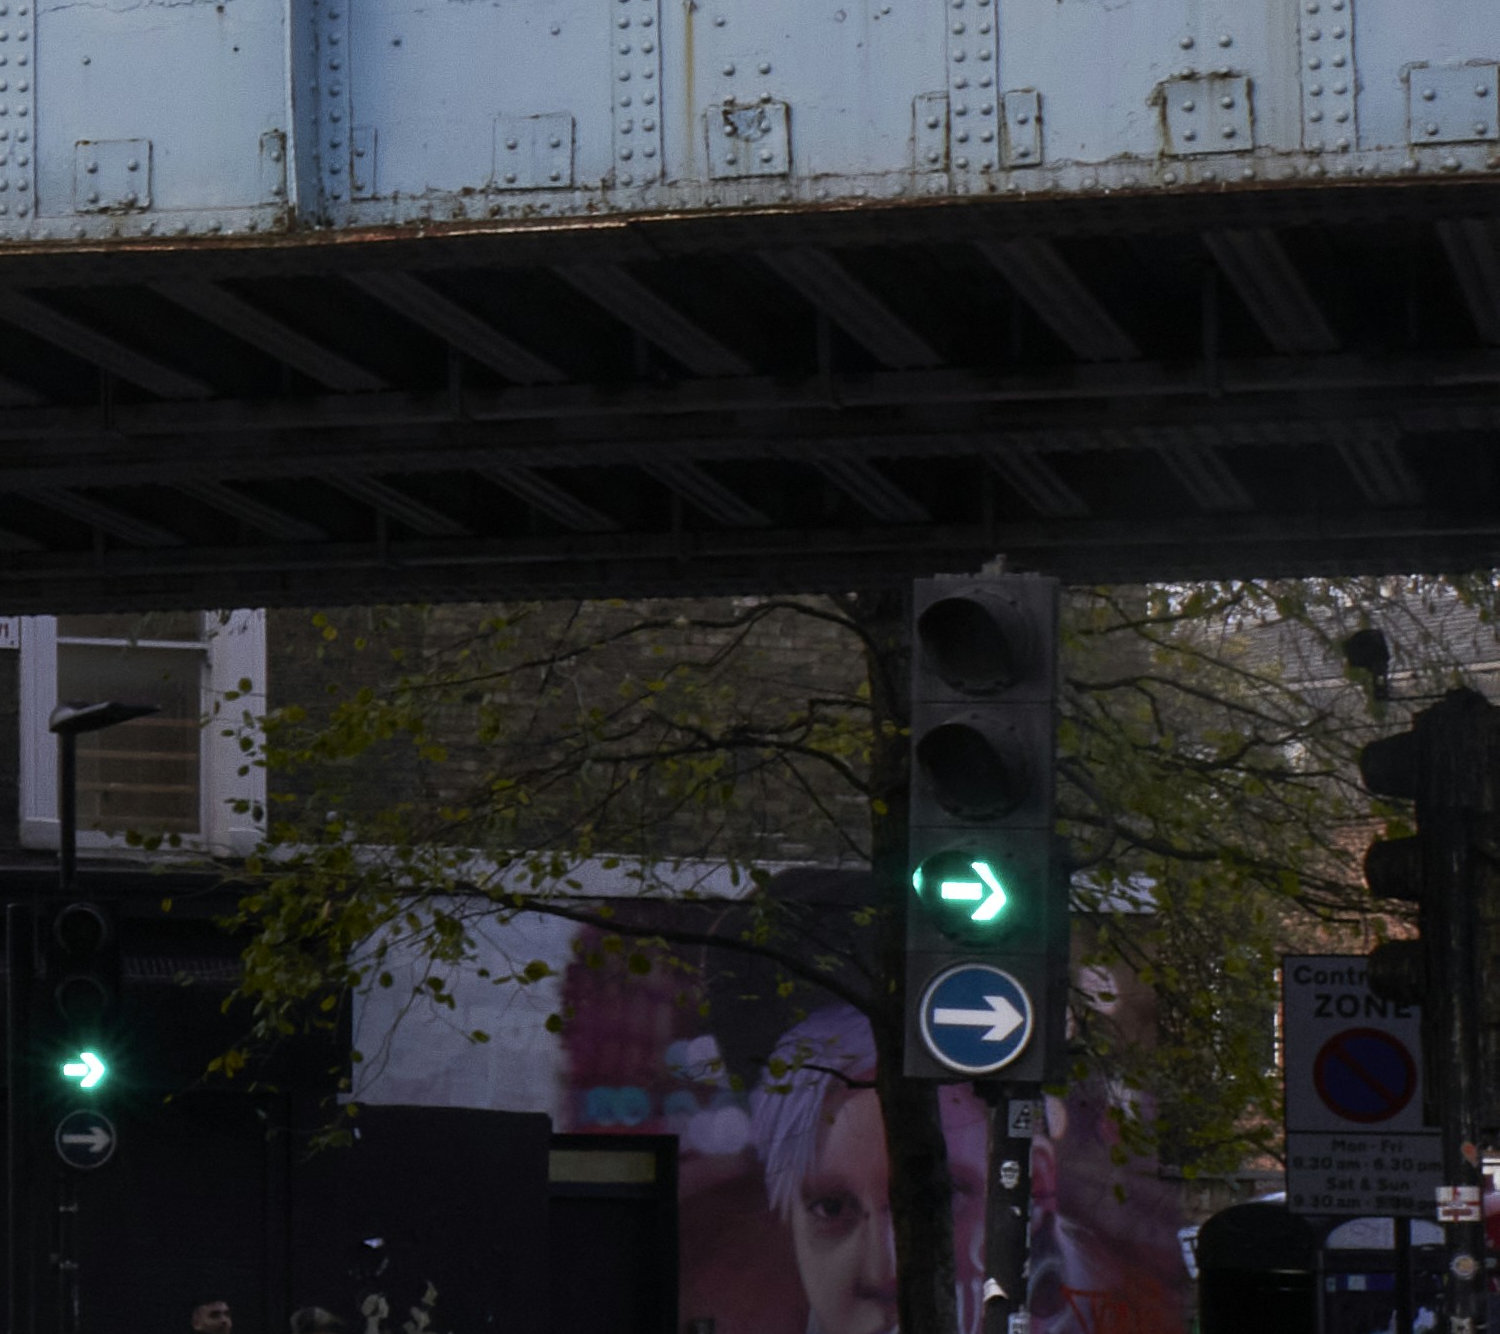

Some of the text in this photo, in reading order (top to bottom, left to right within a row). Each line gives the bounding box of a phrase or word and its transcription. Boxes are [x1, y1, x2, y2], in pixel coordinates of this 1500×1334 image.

[1331, 1140, 1366, 1152] Mon
[1381, 1140, 1403, 1152] Fri
[1336, 1160, 1361, 1170] am
[1417, 1161, 1442, 1173] pm
[1327, 1177, 1410, 1190] Sat & Sun
[1336, 1198, 1361, 1208] am
